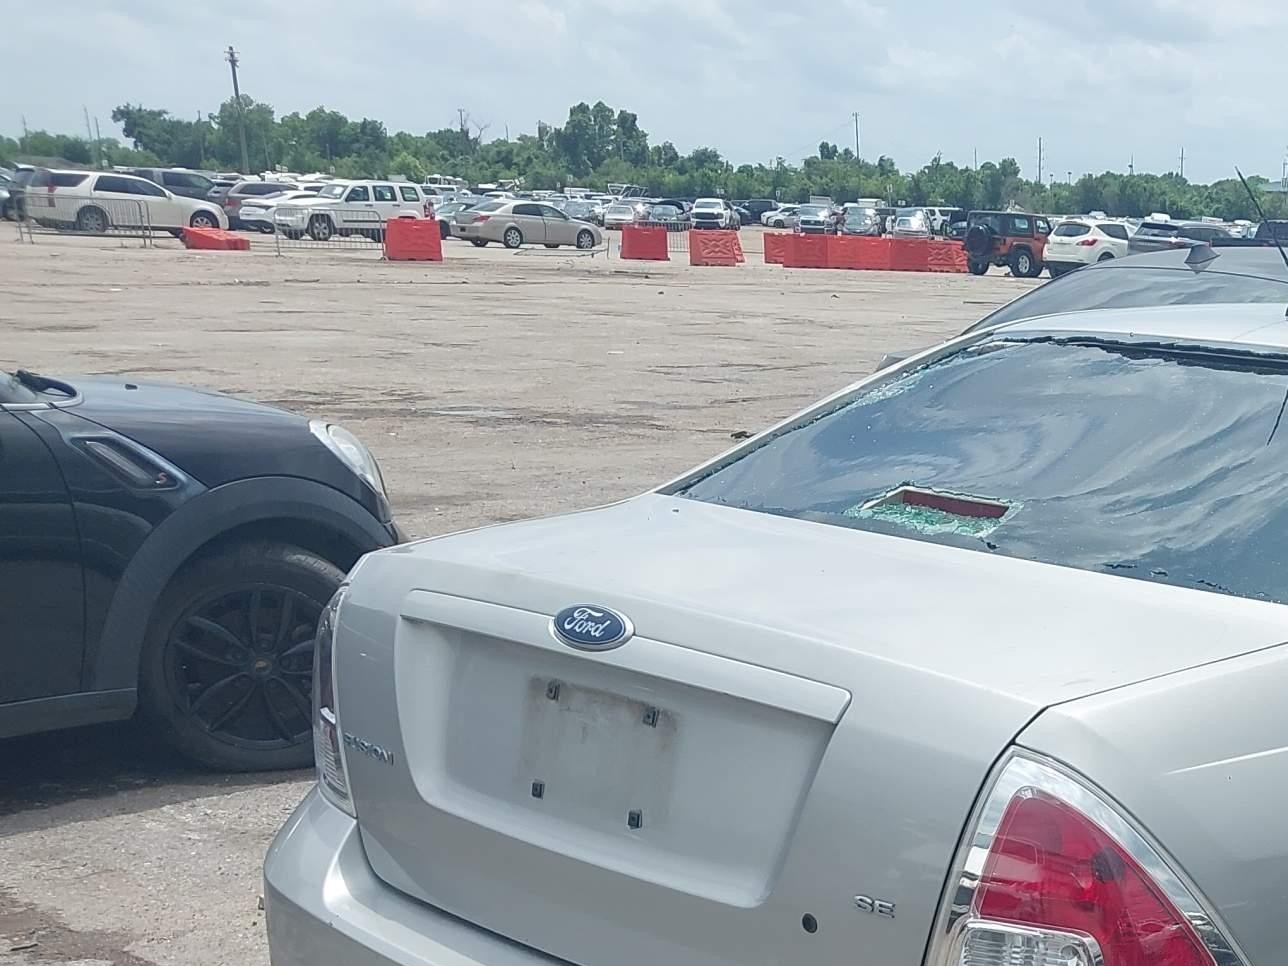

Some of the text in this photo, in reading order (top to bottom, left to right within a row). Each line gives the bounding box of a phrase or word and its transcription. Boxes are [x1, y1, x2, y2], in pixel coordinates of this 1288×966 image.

[563, 607, 611, 638] Ford
[343, 731, 394, 767] FUSION
[853, 894, 895, 918] SE
